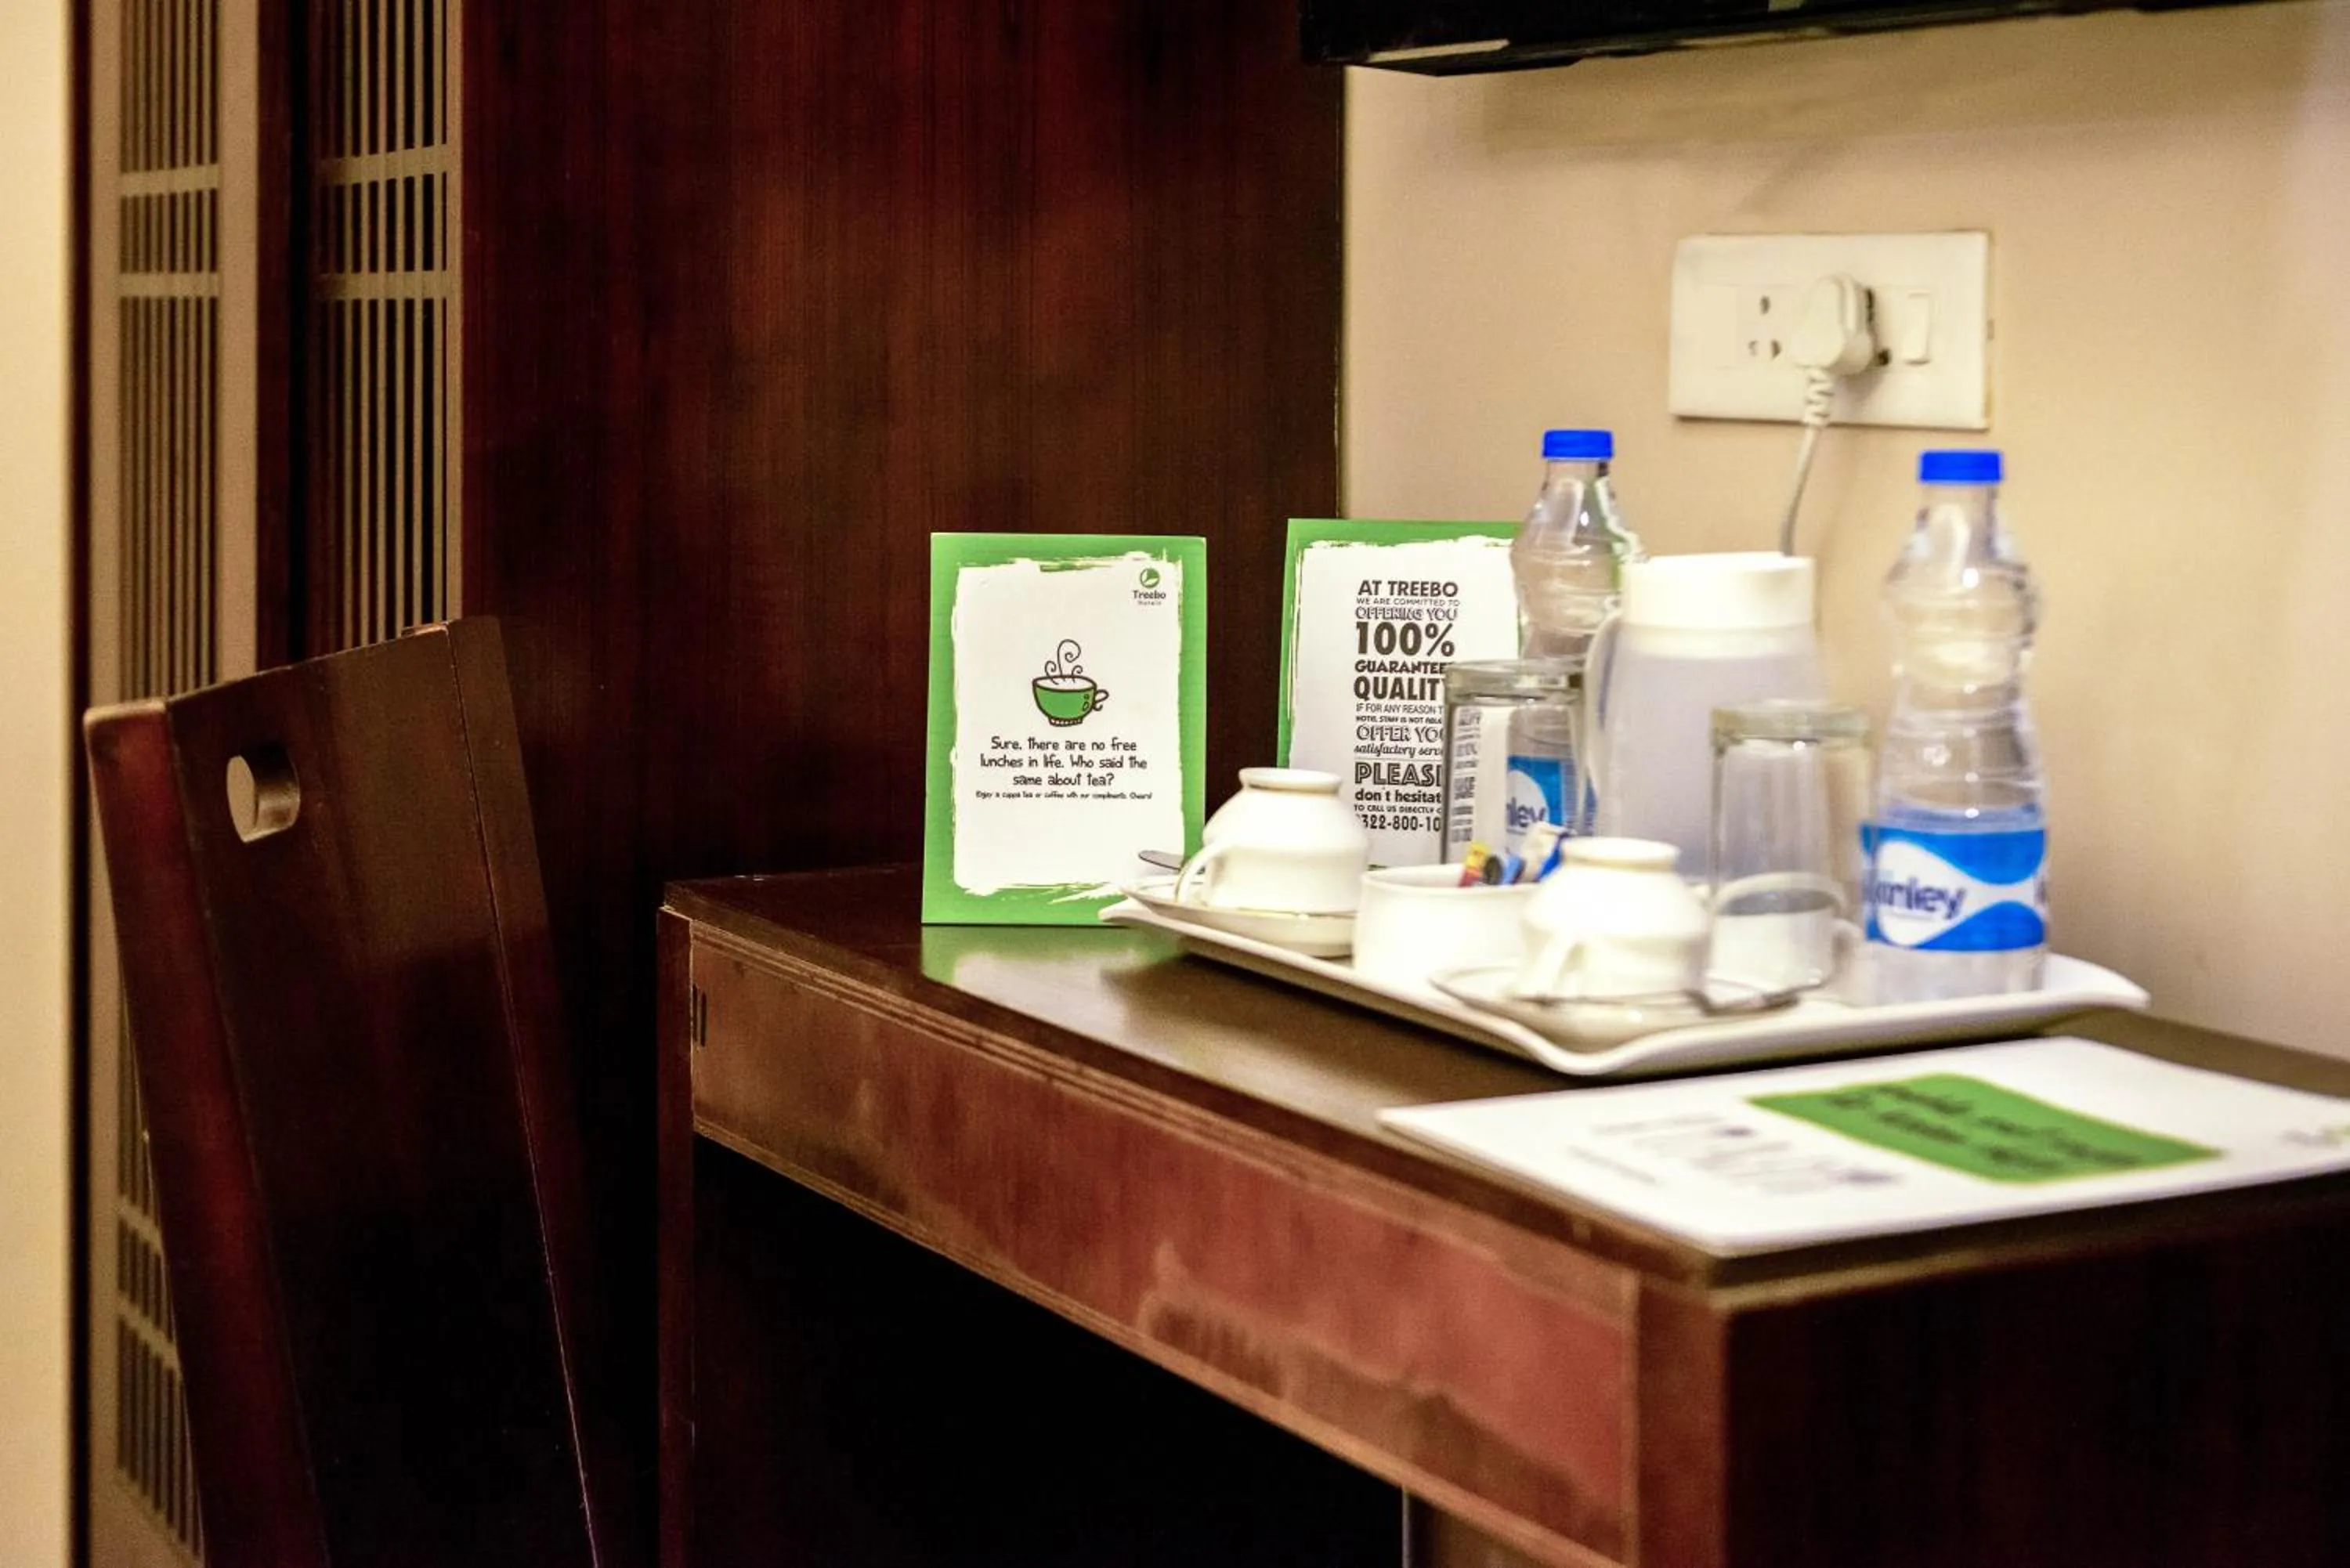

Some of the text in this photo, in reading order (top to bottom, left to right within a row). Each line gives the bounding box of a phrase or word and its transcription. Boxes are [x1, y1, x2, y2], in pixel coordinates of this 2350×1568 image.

[1132, 590, 1166, 599] Treebo
[1358, 580, 1458, 597] AT TREEBO
[1394, 598, 1446, 607] COMMITTED
[1355, 606, 1458, 621] OFFERING YOU
[1356, 621, 1455, 657] 100%
[1354, 659, 1454, 674] GUARANTEE
[1354, 675, 1444, 701] QUALIT
[1356, 703, 1364, 712] IF
[1365, 703, 1383, 713] FOR
[1383, 704, 1401, 713] ANY
[1402, 704, 1435, 714] REASON
[1356, 724, 1411, 742] OFFER
[1027, 736, 1060, 750] there
[1065, 740, 1086, 750] are
[1091, 742, 1105, 751] no
[1111, 736, 1137, 751] free
[1354, 742, 1416, 758] satisfactory
[980, 753, 1023, 768] lunches
[1028, 756, 1039, 768] in
[1069, 754, 1094, 768] Who
[1099, 755, 1123, 768] said
[1129, 755, 1148, 769] the
[1013, 772, 1115, 786] same about tea?
[1354, 787, 1442, 804] don't hesitat
